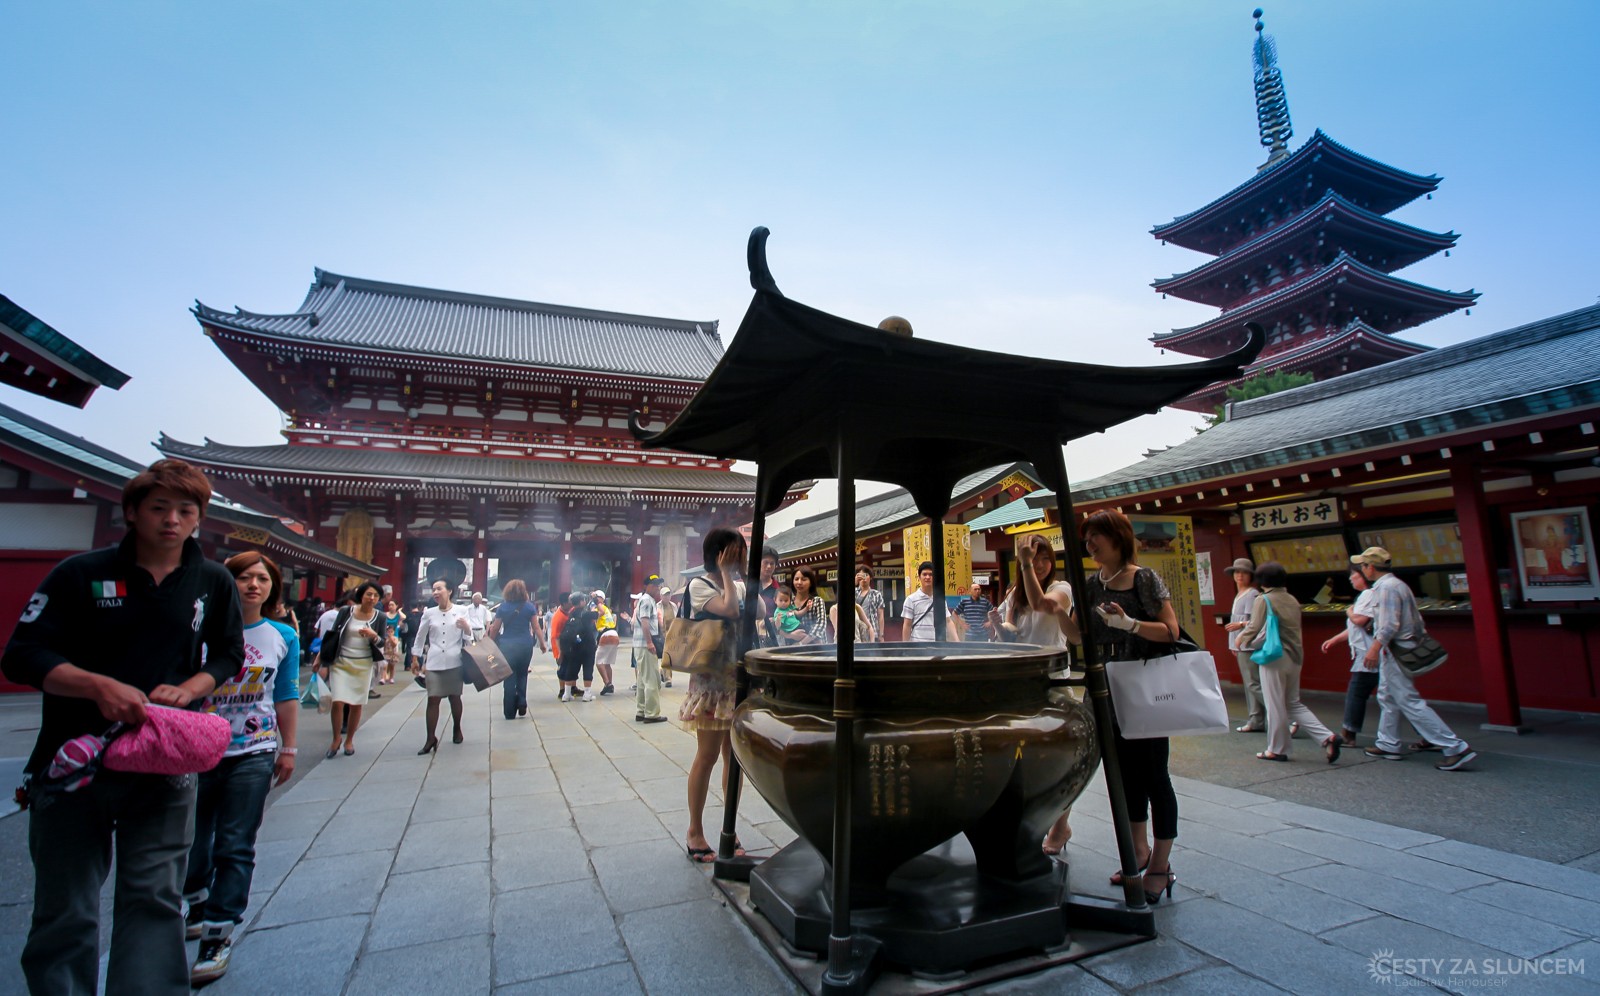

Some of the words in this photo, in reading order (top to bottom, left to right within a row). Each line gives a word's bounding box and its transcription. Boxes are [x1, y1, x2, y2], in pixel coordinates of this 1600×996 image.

[1252, 502, 1332, 528] お札お守
[97, 598, 123, 608] ITALY
